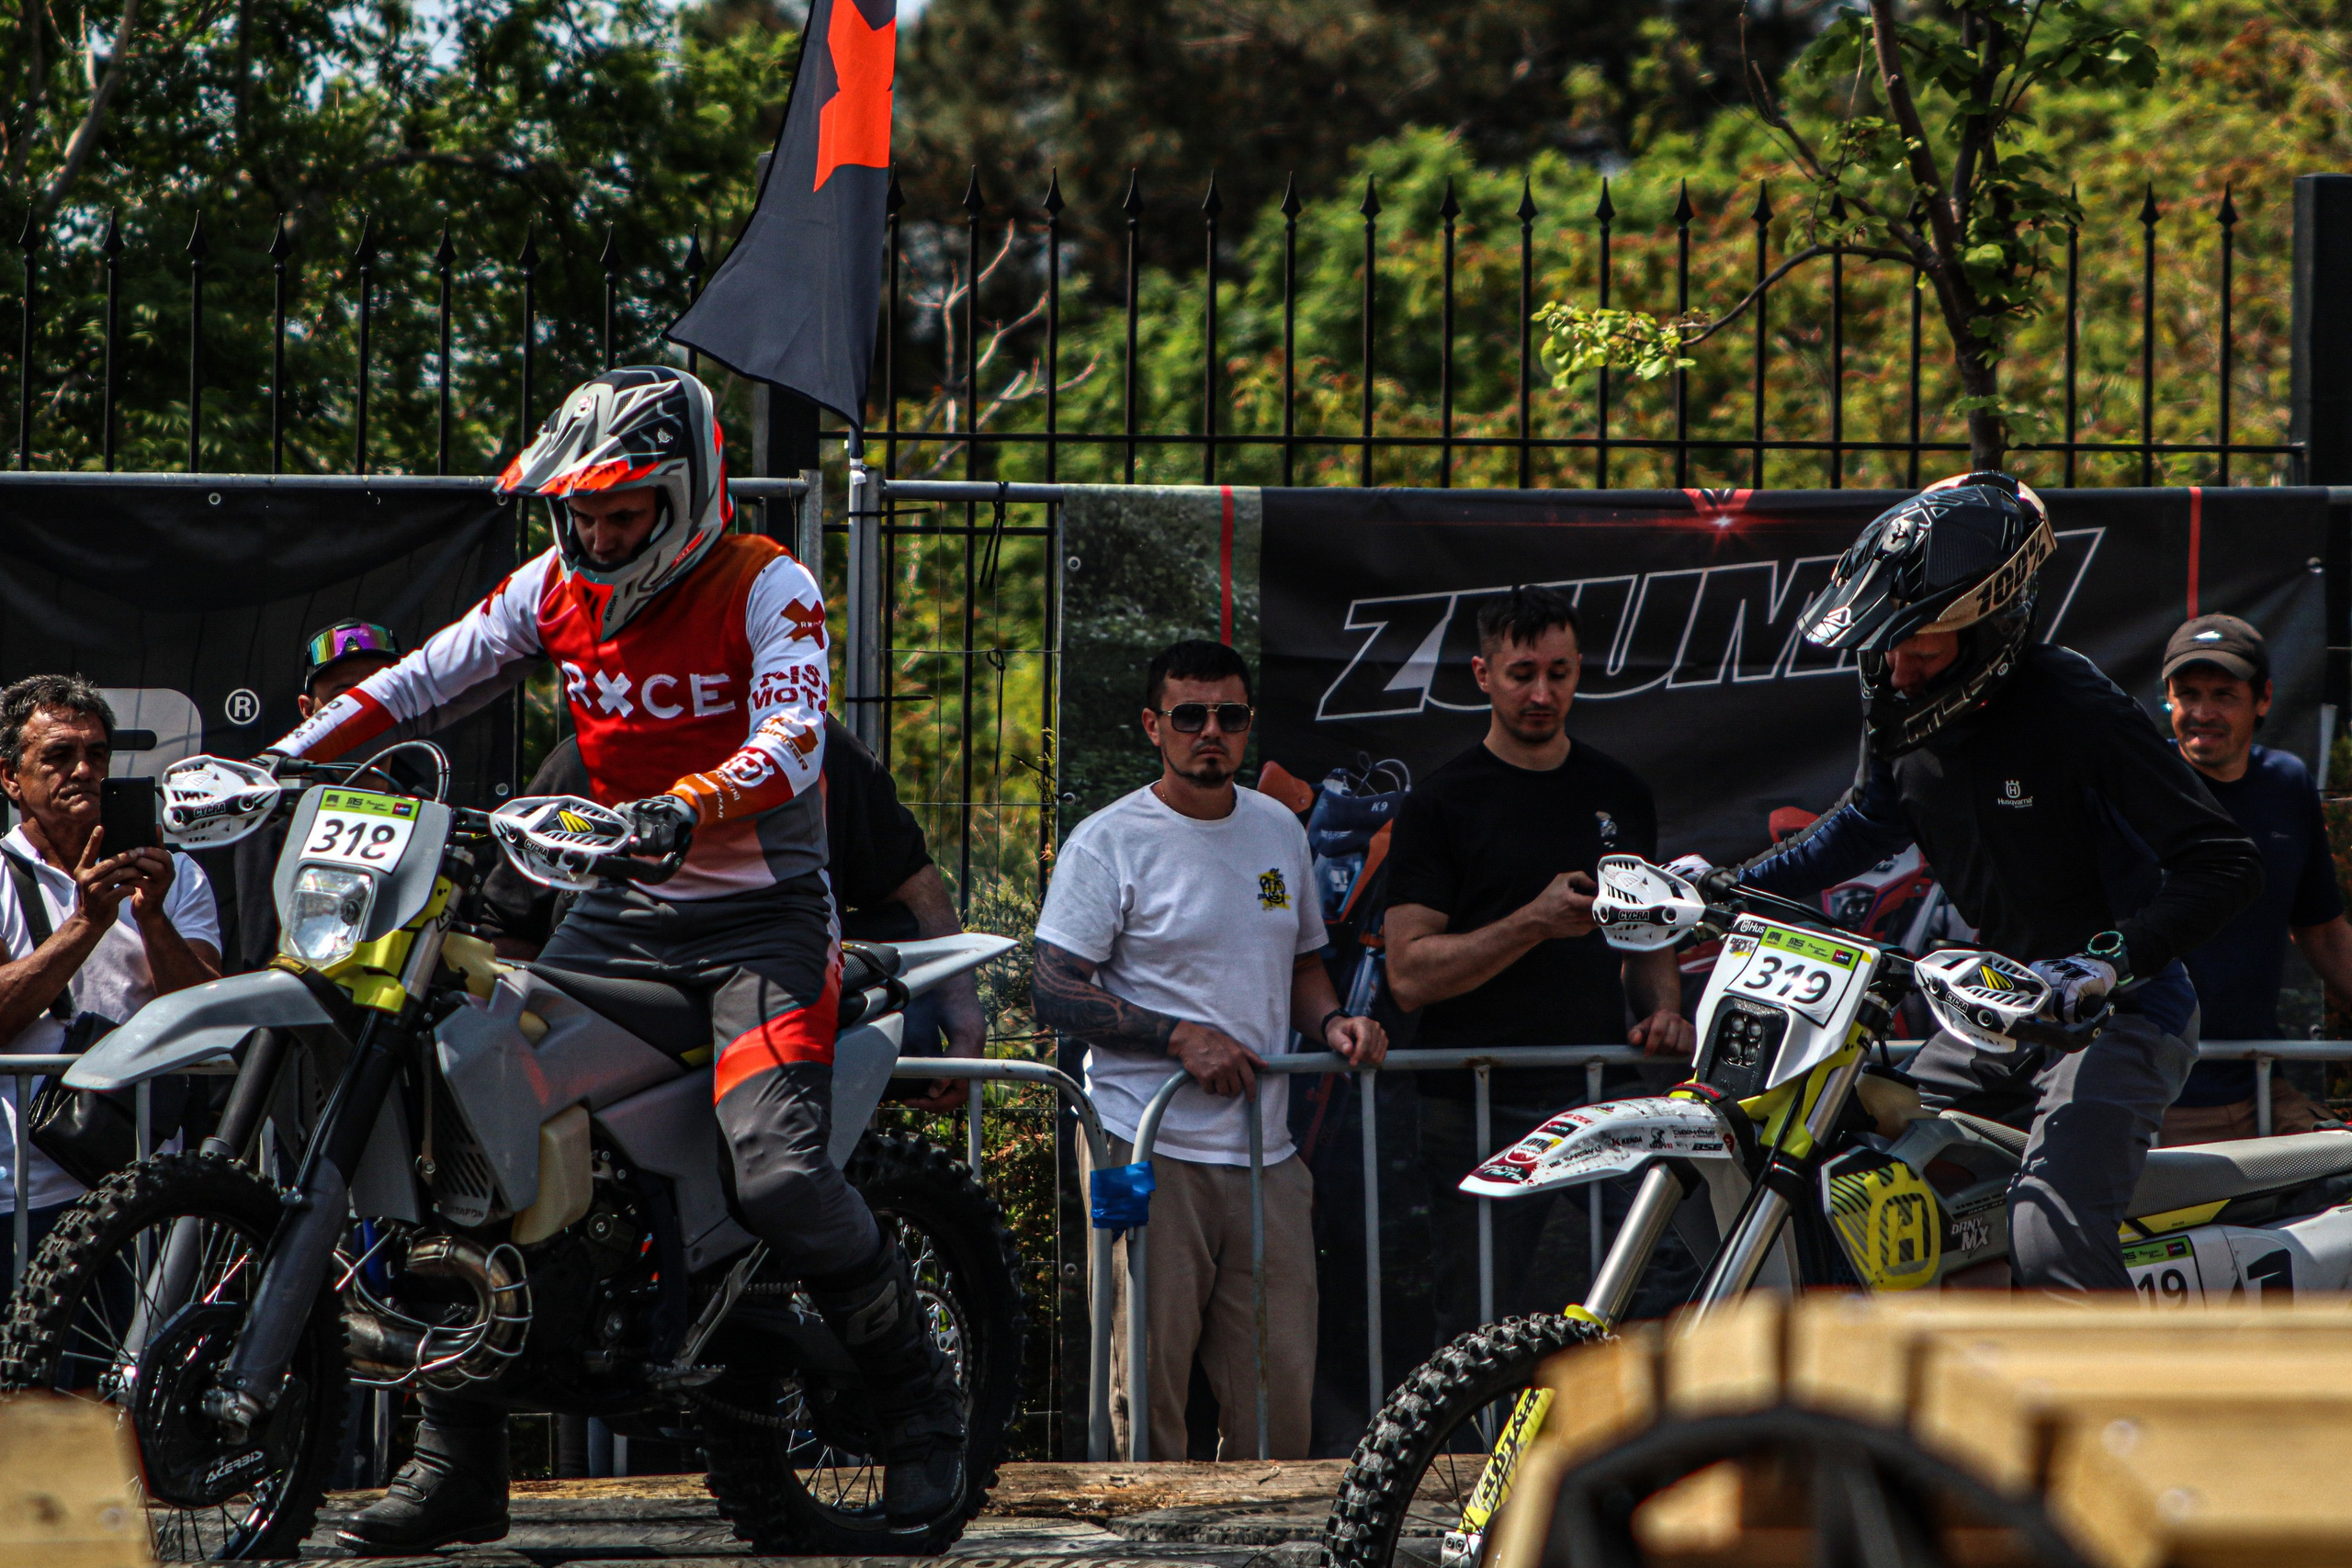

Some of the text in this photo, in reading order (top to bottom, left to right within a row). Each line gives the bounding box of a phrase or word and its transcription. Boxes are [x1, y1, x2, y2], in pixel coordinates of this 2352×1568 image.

[1975, 528, 2047, 617] 100%
[194, 803, 227, 818] CYCRA
[1372, 802, 1388, 812] K9
[1997, 797, 2033, 807] Husqvarna
[309, 818, 396, 860] 318
[524, 838, 549, 859] CYCRA
[1618, 910, 1650, 921] CYCRA
[1749, 921, 1766, 933] Hus
[1743, 956, 1832, 1005] 319
[1945, 990, 1969, 1013] CYCRA
[1691, 1143, 1724, 1151] BSE
[1951, 1216, 1984, 1235] DANY
[2137, 1268, 2189, 1310] 19
[205, 1450, 264, 1484] ACERBIS
